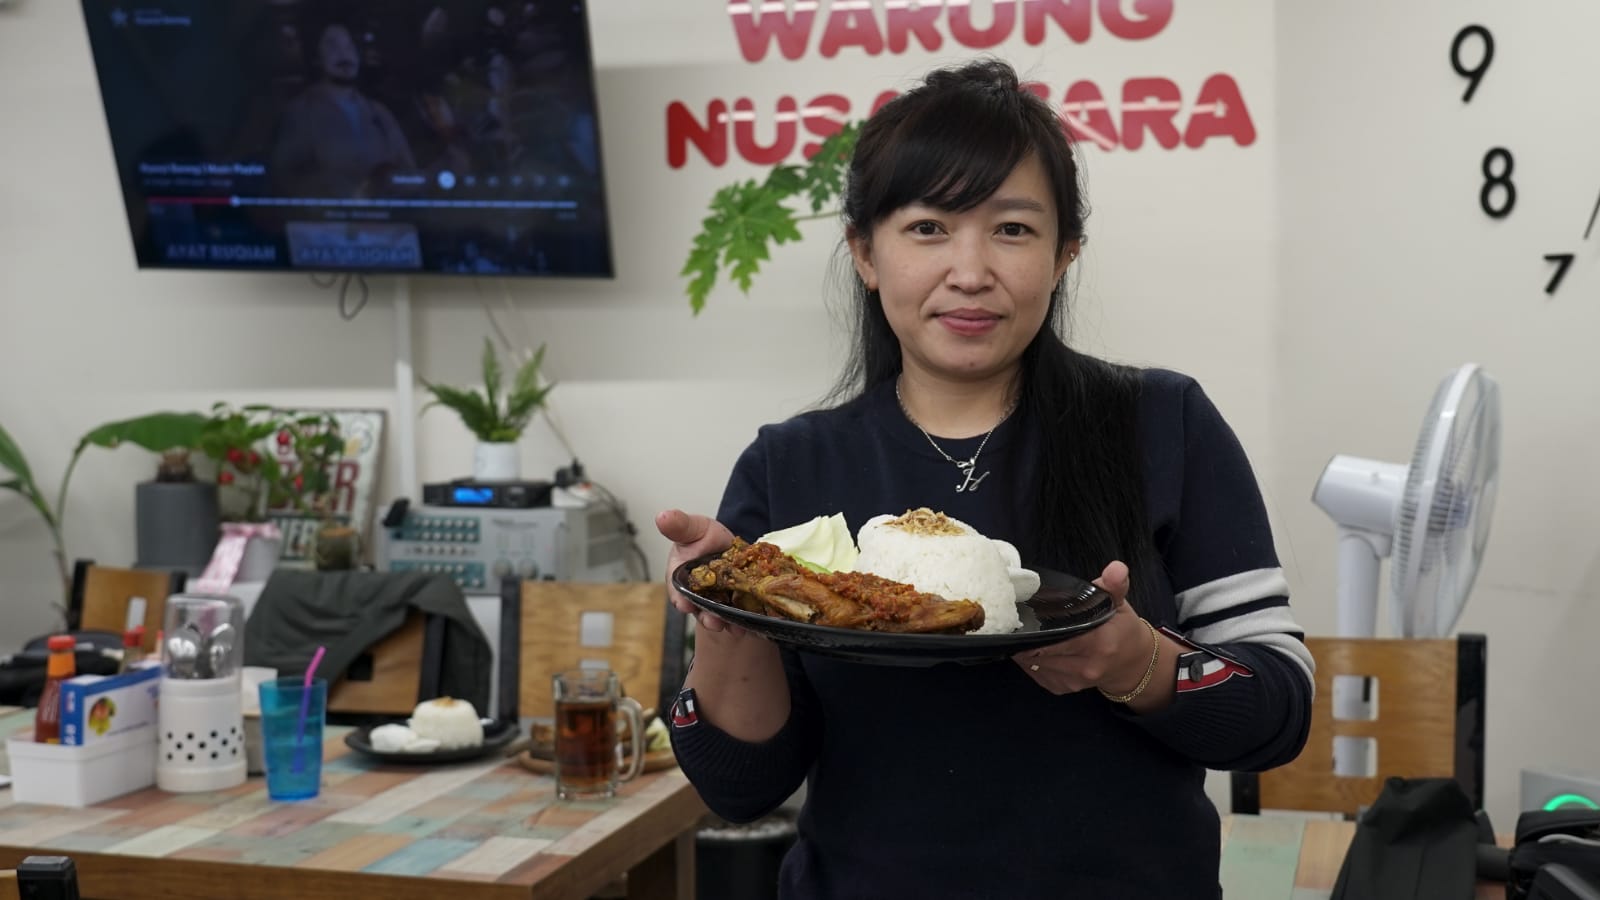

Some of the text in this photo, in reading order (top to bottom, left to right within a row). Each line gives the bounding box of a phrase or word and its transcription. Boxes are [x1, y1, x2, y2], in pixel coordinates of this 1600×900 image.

[729, 0, 1174, 63] WARUNG
[1449, 24, 1494, 103] 9
[666, 73, 1256, 170] NUSARA
[1480, 147, 1516, 219] 8
[1544, 253, 1576, 296] 7
